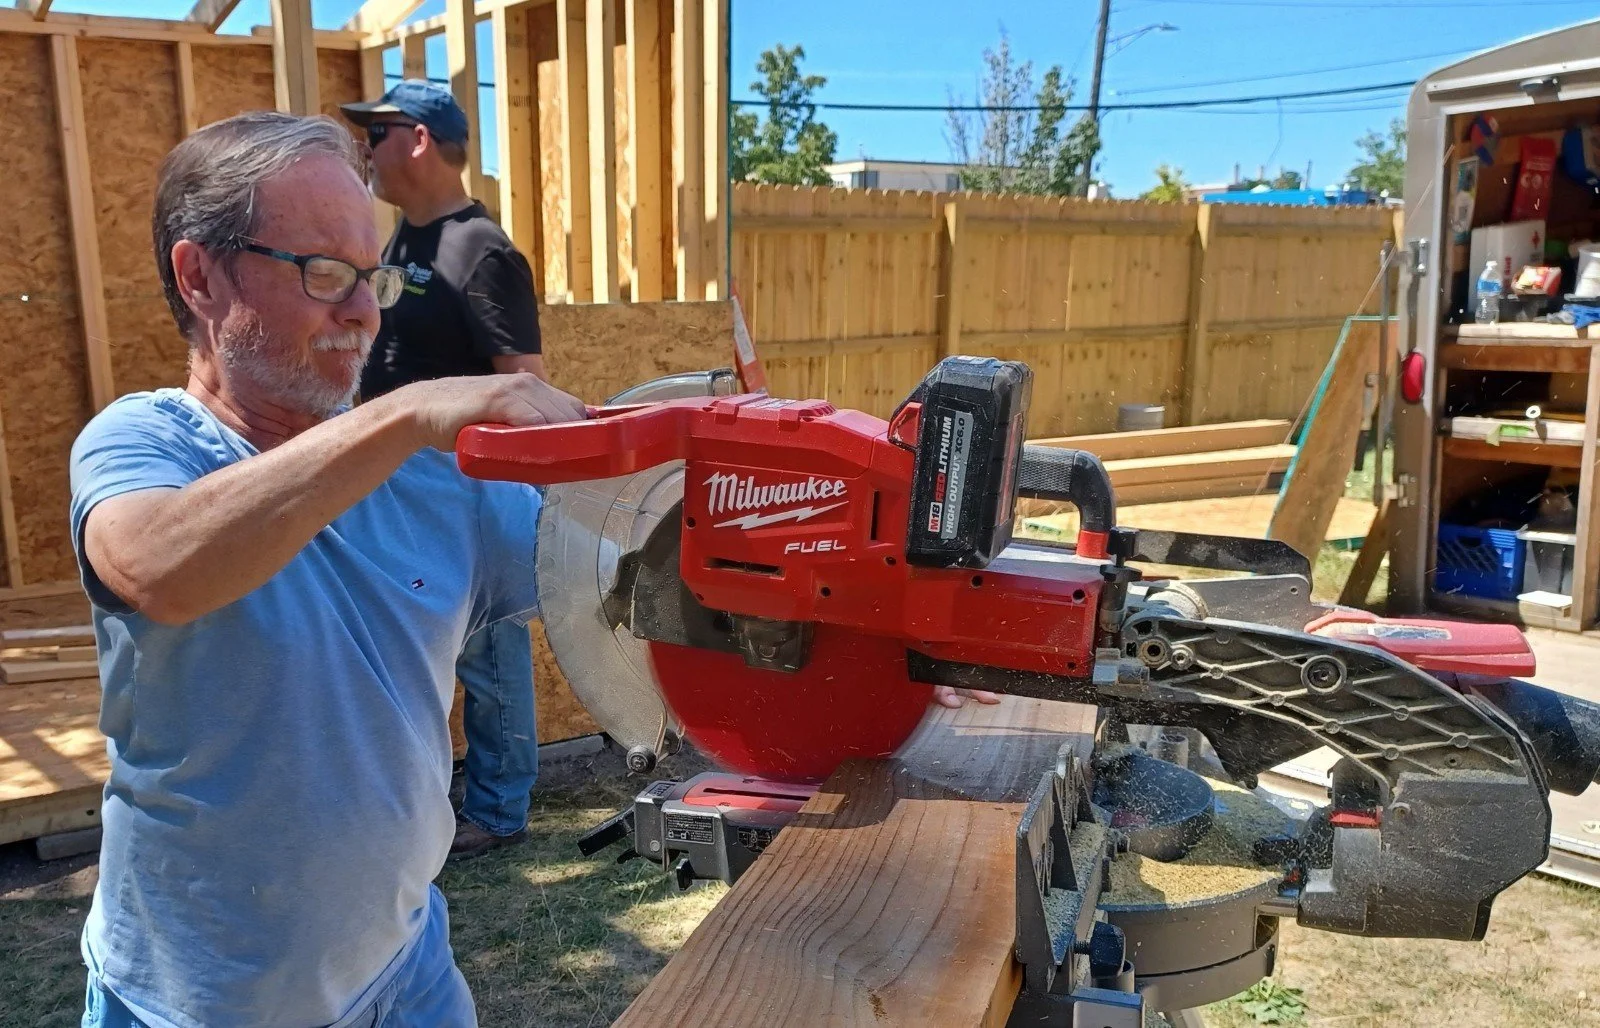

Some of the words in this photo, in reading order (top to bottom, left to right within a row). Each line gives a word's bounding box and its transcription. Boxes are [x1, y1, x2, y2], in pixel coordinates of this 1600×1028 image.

[954, 417, 965, 454] XC6.0
[702, 471, 848, 516] Milwaukee
[949, 455, 962, 501] OUTPUT
[930, 504, 941, 531] M18
[946, 504, 956, 533] HIGH
[784, 539, 847, 555] FUEL
